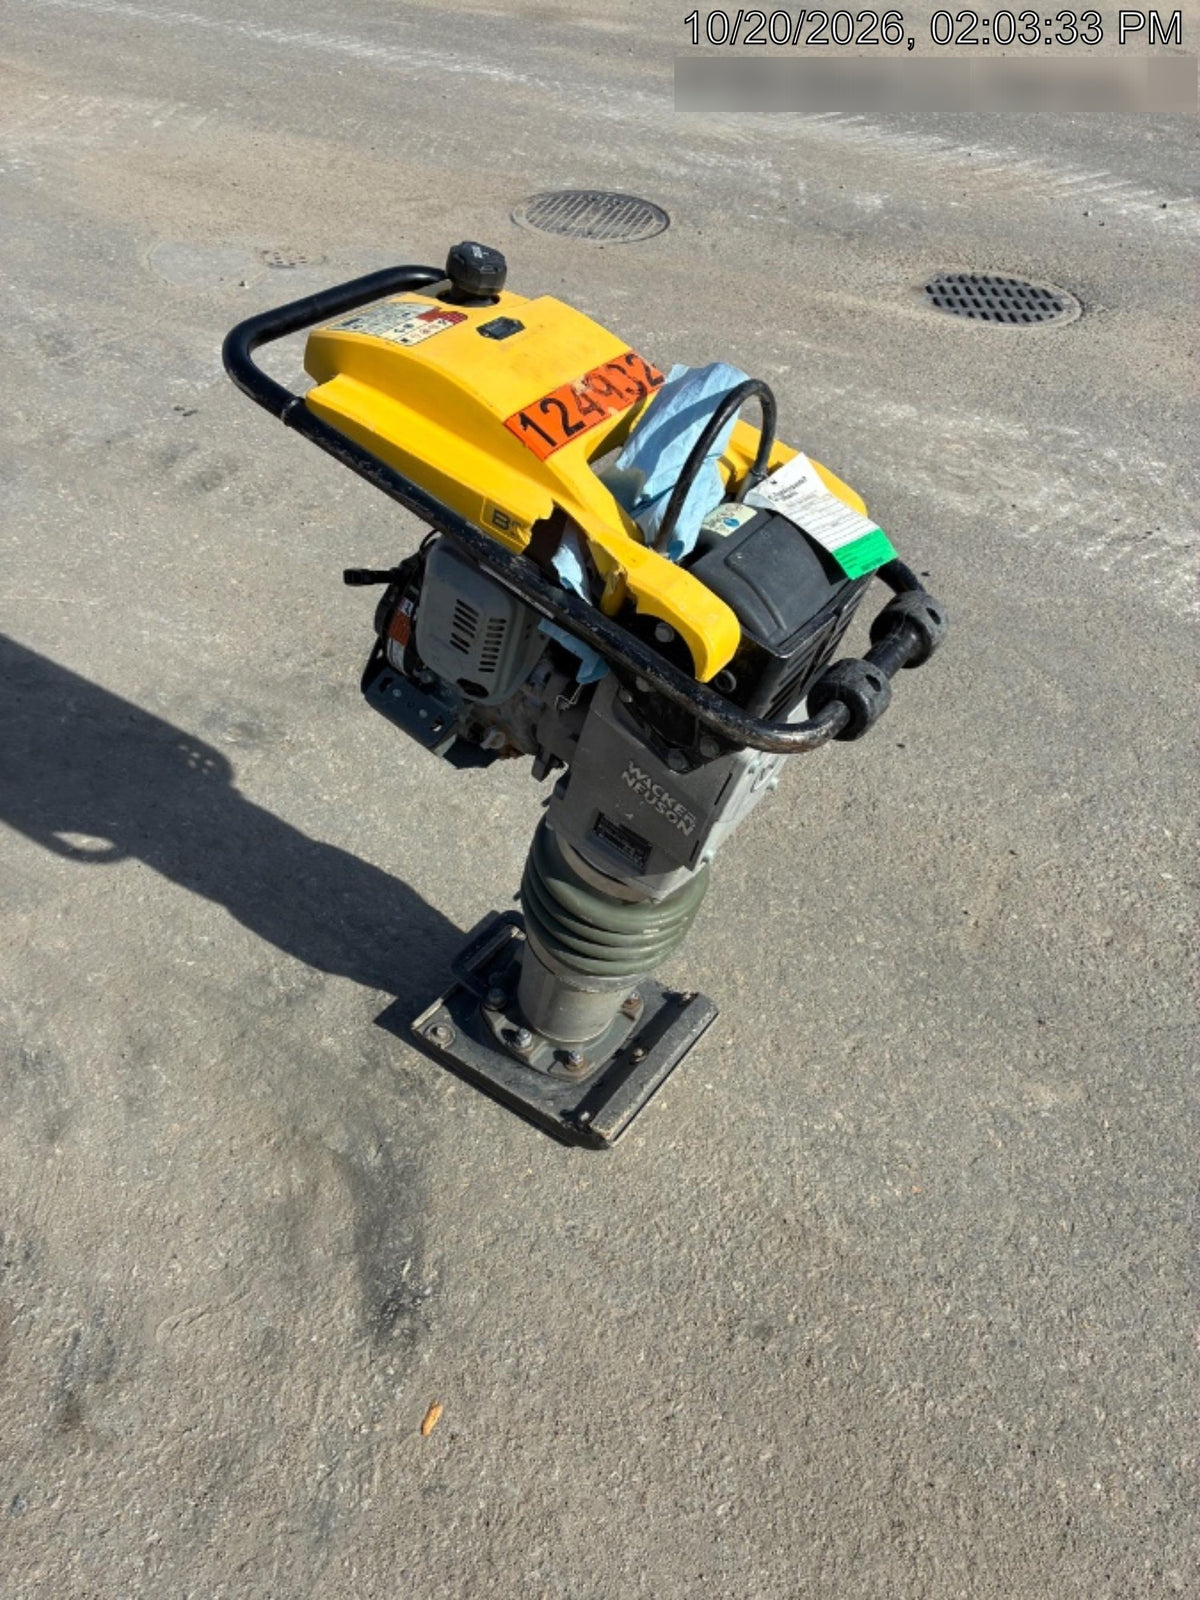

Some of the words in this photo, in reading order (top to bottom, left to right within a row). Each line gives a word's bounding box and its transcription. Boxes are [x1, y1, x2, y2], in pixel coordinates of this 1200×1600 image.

[519, 353, 665, 447] 124932
[621, 771, 694, 837] NEUSON
[629, 761, 696, 828] WACKER
